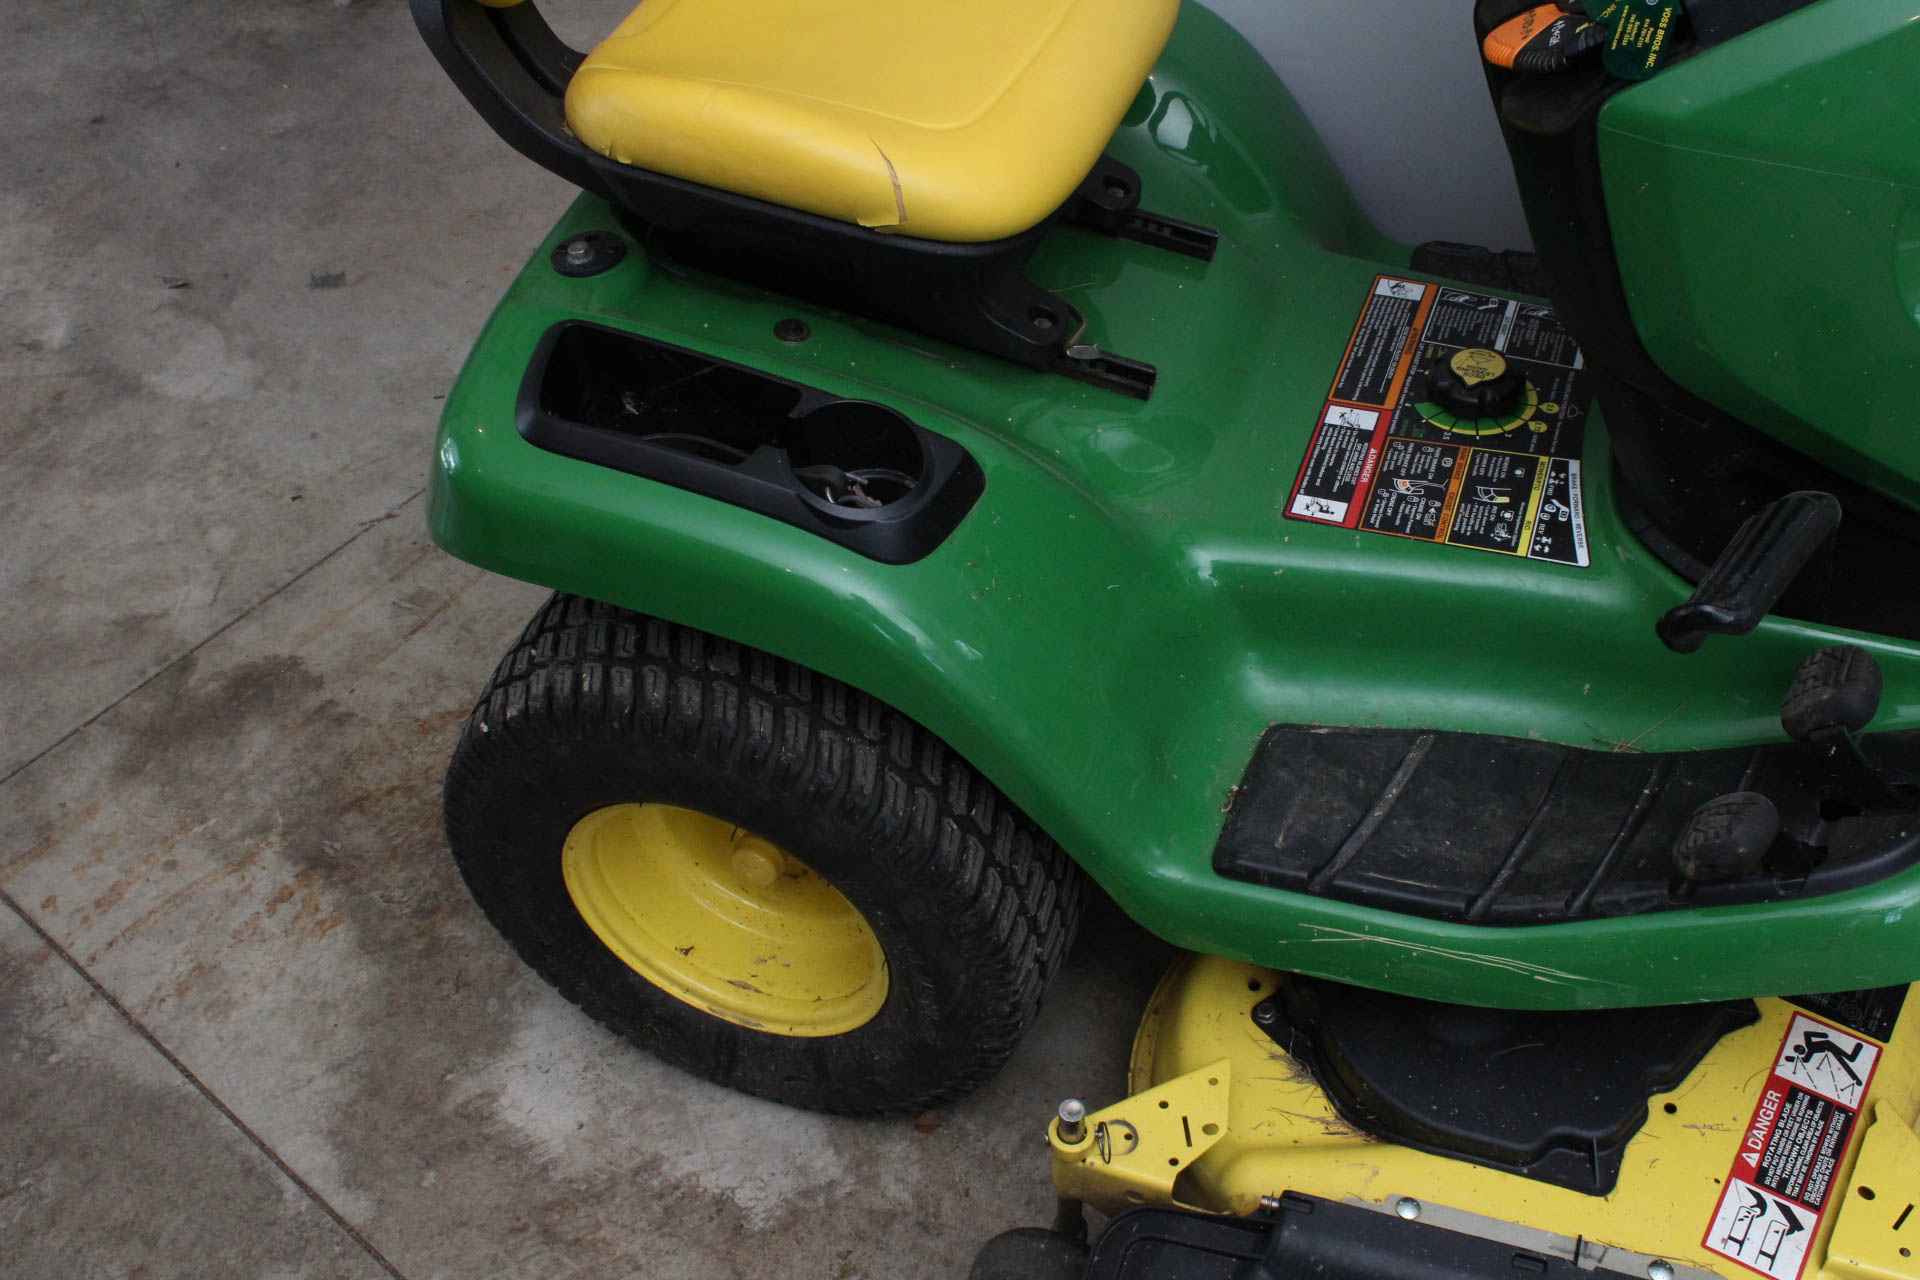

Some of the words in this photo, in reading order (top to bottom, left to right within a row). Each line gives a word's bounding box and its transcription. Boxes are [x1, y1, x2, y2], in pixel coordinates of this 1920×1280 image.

[1658, 7, 1672, 28] VOSS
[1650, 28, 1665, 53] BROS.
[1644, 52, 1657, 69] INC.
[1441, 431, 1451, 440] 3.5
[1359, 454, 1375, 483] DANGER
[1444, 491, 1455, 511] CRUISE
[1436, 513, 1448, 538] CONTROL
[1537, 523, 1545, 534] REV
[1746, 1088, 1782, 1150] DANGER
[1761, 1127, 1782, 1168] ROTATING
[1777, 1101, 1792, 1128] BLADE
[1781, 1144, 1800, 1179] THROWN
[1794, 1108, 1813, 1144] OBJECTS
[1813, 1180, 1827, 1205] CATCHER
[1824, 1158, 1835, 1175] PLACE
